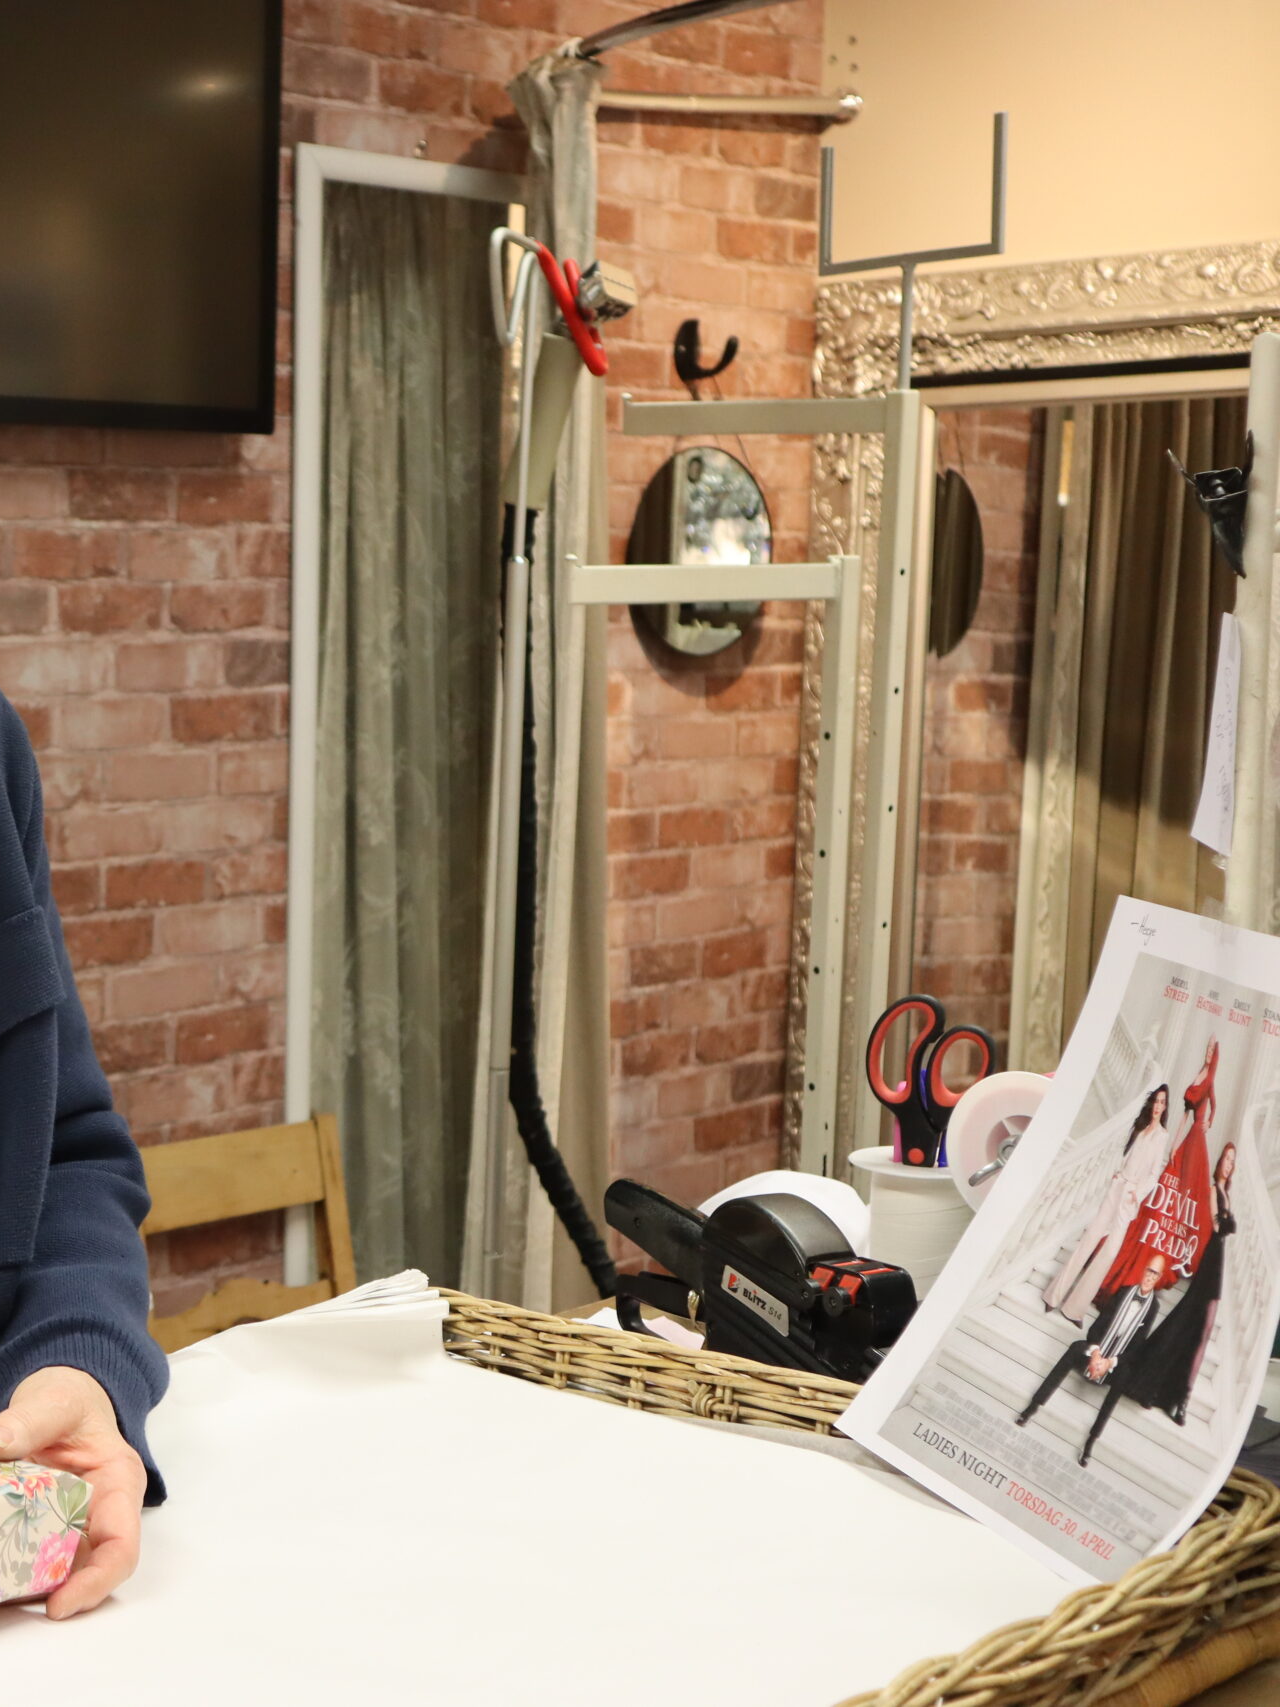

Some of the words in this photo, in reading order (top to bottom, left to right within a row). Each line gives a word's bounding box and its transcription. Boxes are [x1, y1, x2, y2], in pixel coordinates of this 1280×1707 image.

[1163, 1172, 1180, 1189] THE
[1145, 1183, 1200, 1231] DEVIL
[1160, 1215, 1187, 1237] WEARS
[912, 1422, 959, 1460] LADIES
[957, 1452, 1008, 1490] NIGHT
[1006, 1480, 1064, 1527] TORSDAG
[1059, 1518, 1076, 1538] 30.
[1077, 1531, 1116, 1561] APRIL
